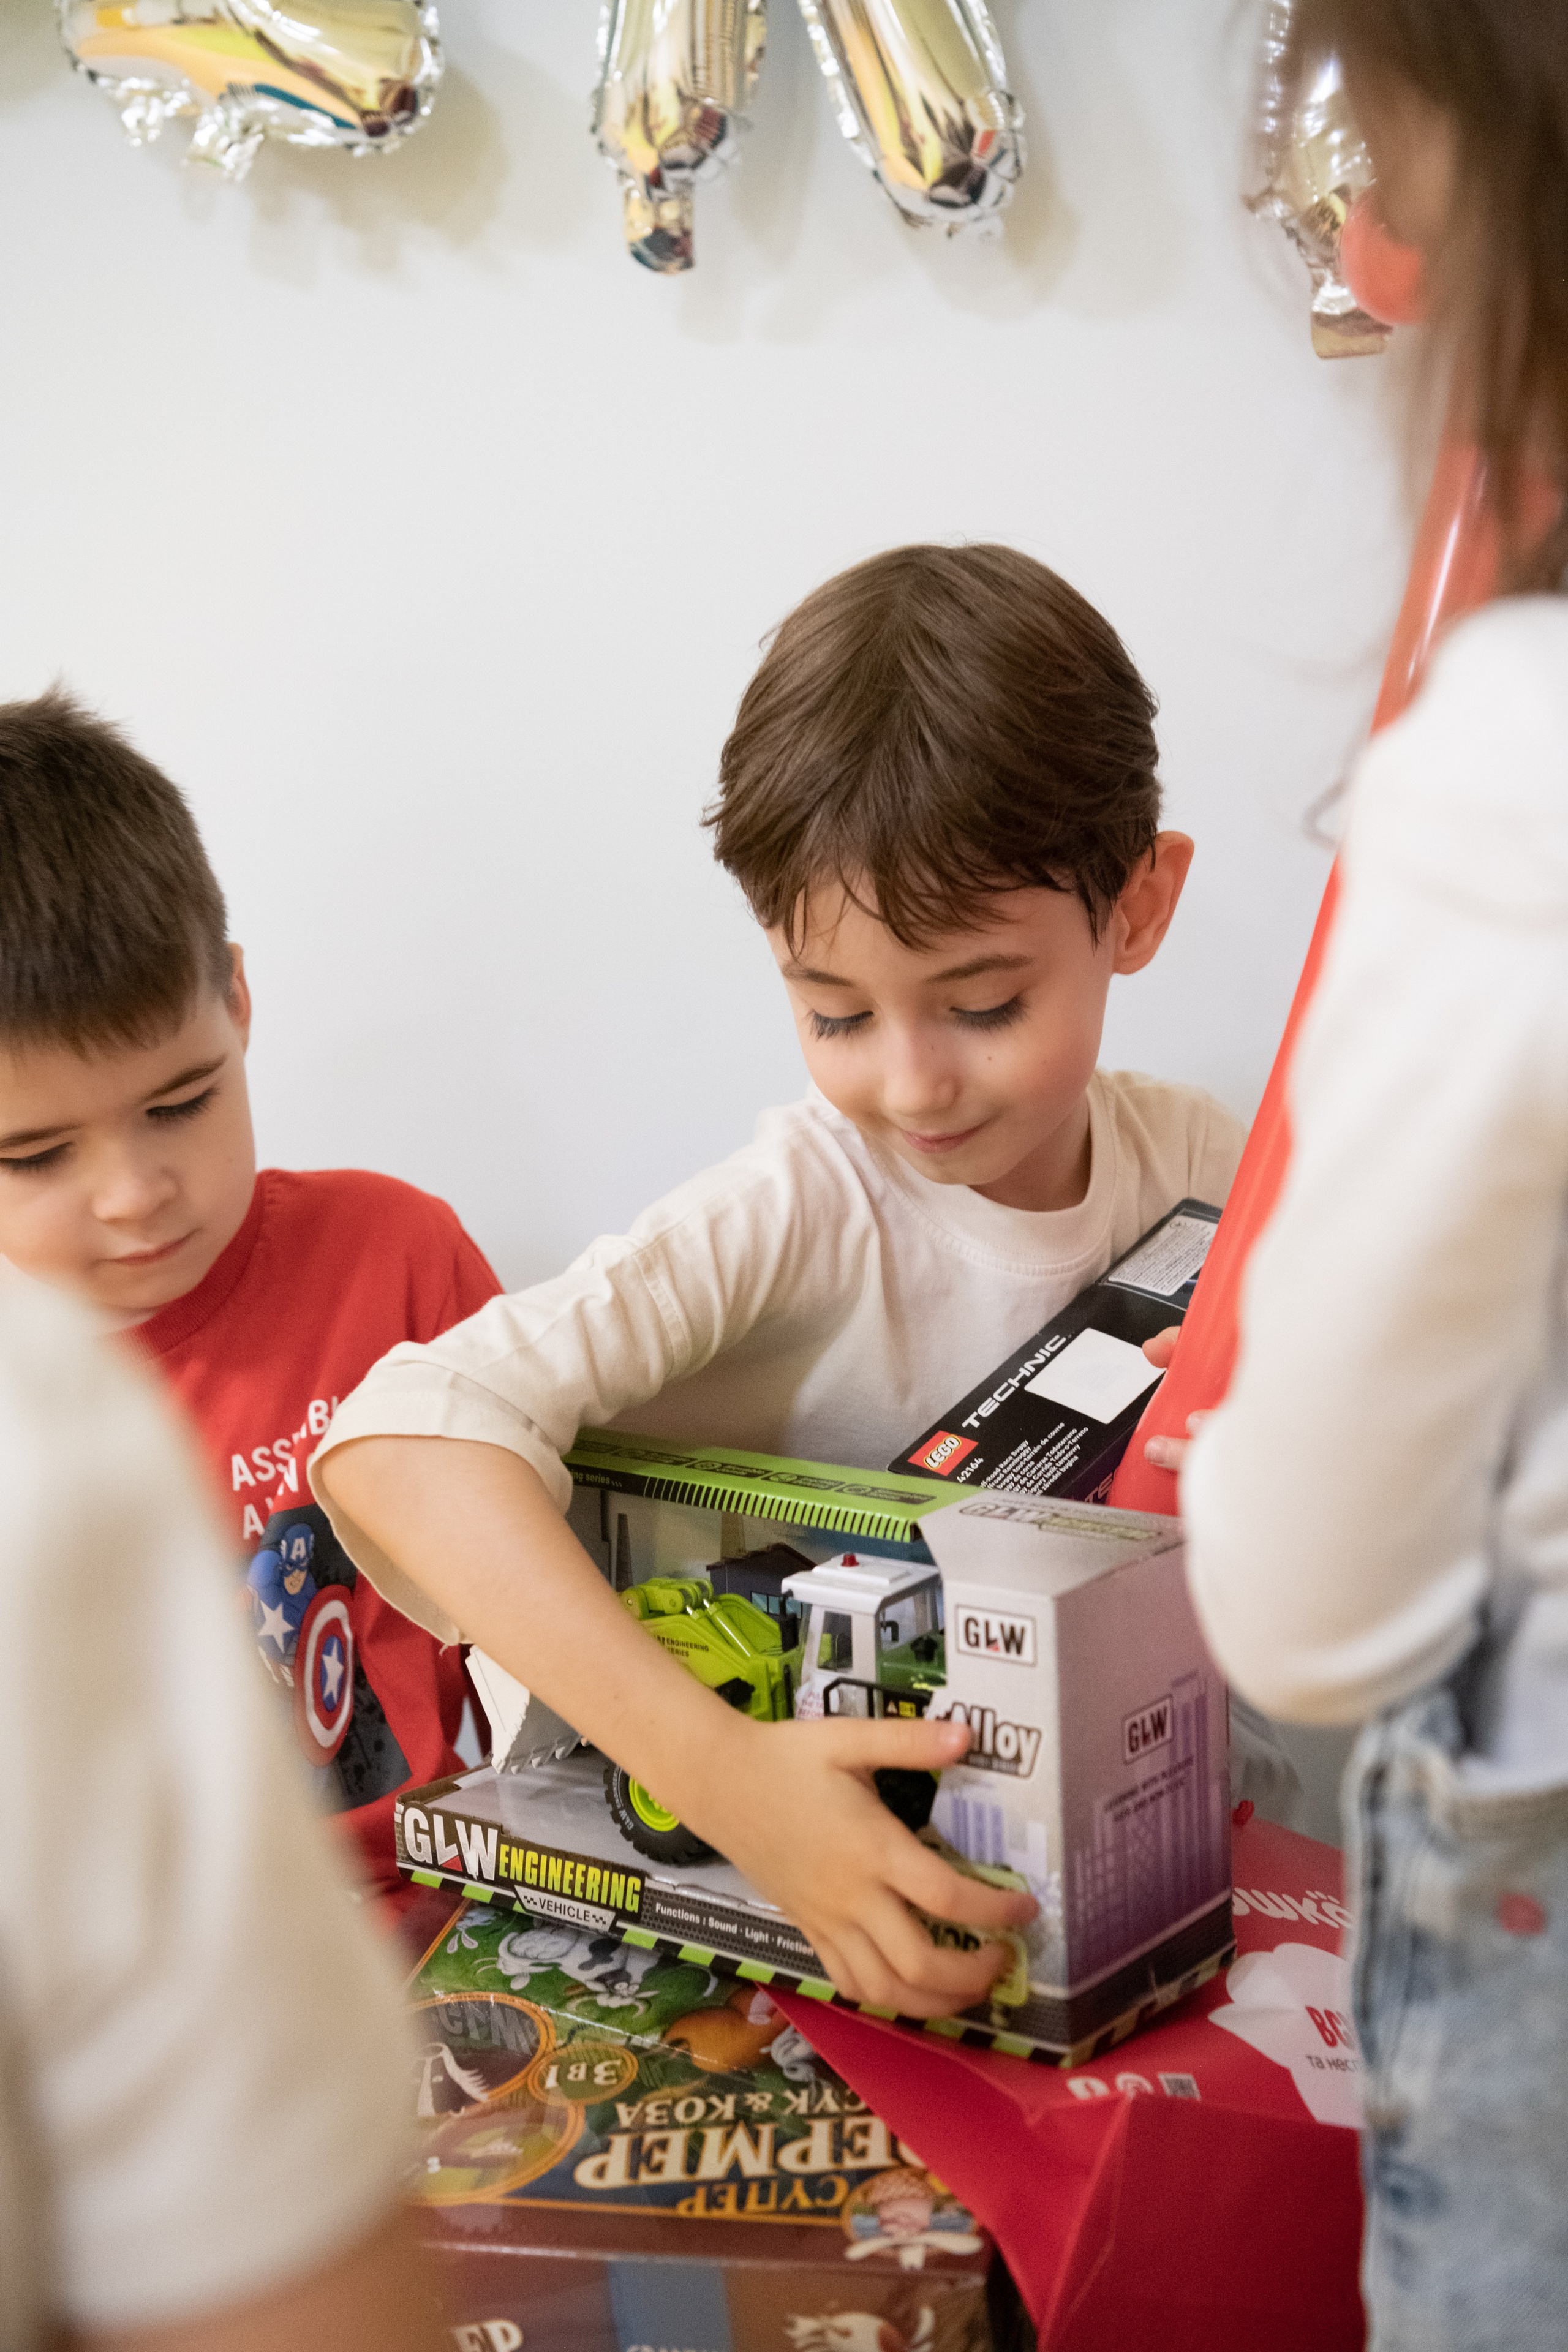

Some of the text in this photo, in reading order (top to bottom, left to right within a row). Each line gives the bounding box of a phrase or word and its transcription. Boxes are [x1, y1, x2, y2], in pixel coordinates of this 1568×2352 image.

[962, 1335, 1066, 1428] TECHNIC
[924, 1435, 961, 1469] LEGO
[956, 1457, 984, 1483] 42164
[965, 1616, 1025, 1655] GLW
[1128, 1706, 1168, 1753] GLW
[403, 1807, 641, 1913] GLW ENGINEERING
[540, 1898, 590, 1922] VEHICLE
[655, 1902, 815, 1956] Functions Sound Light Friction
[615, 2093, 736, 2128] КОЗА
[575, 2115, 927, 2190] ЕРМЕР
[676, 2175, 850, 2217] СУПЕР
